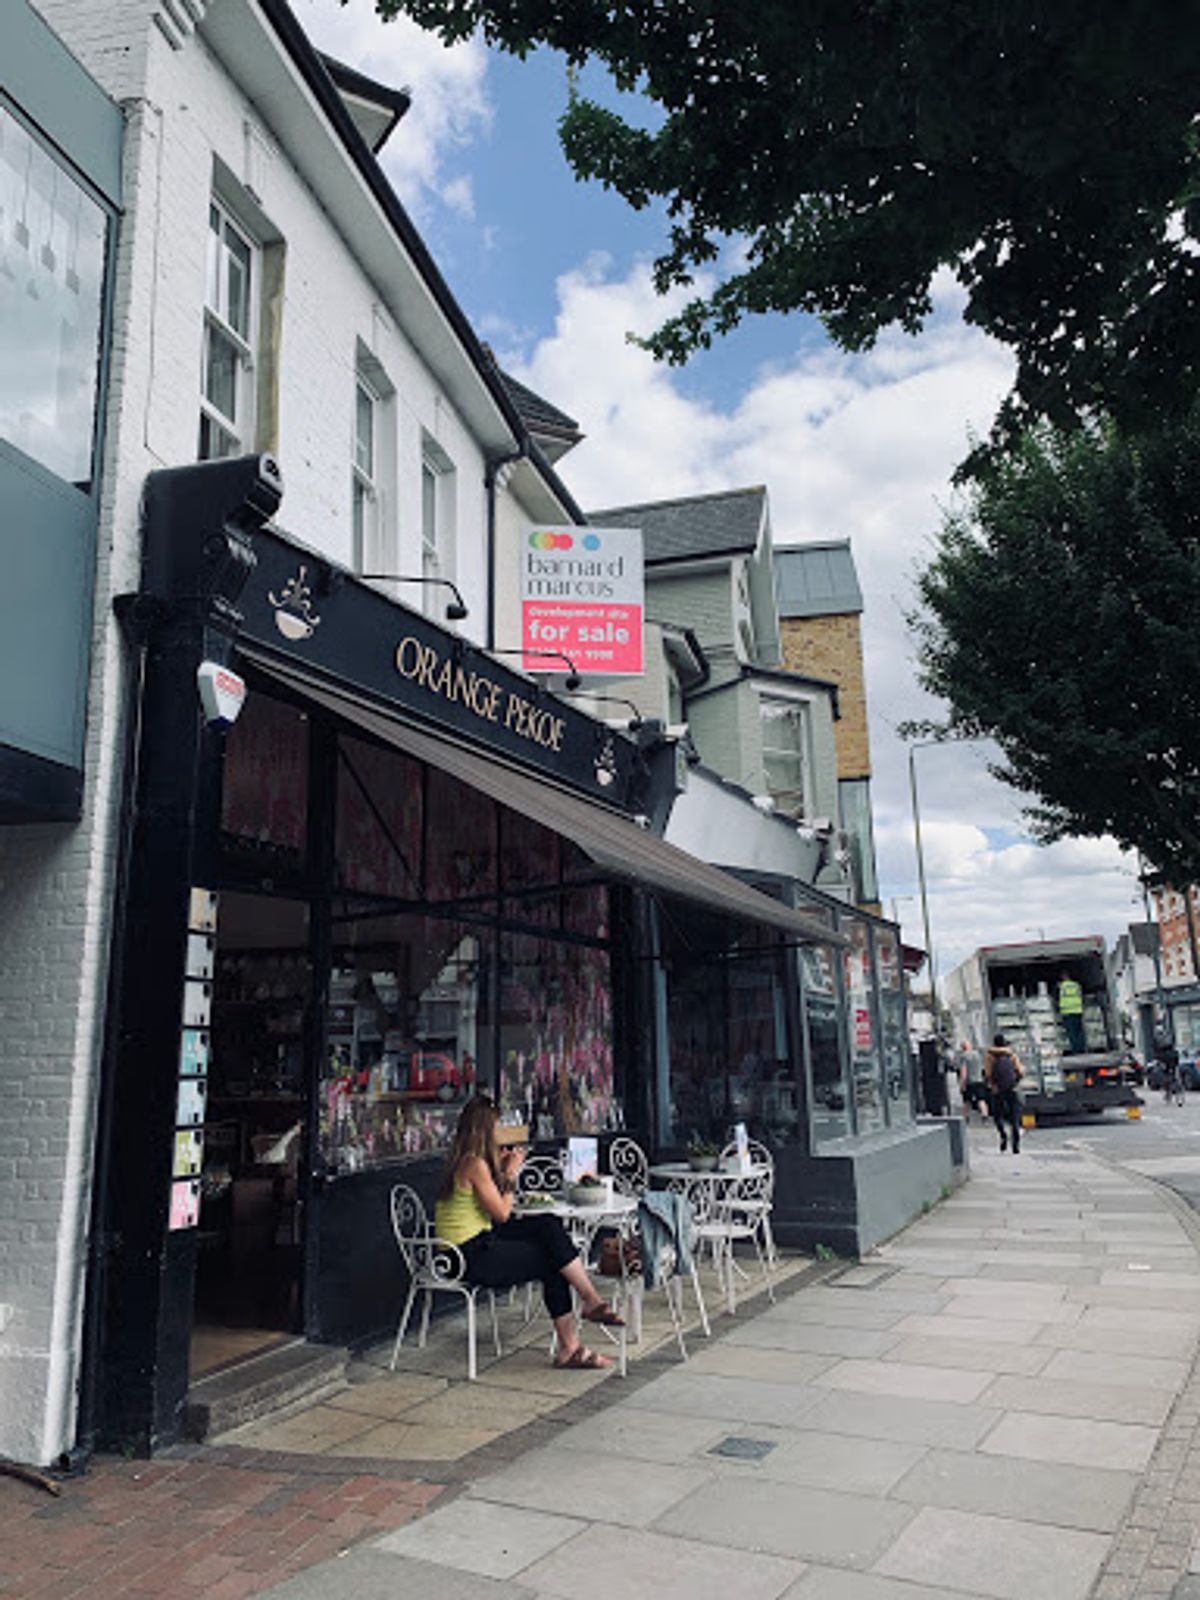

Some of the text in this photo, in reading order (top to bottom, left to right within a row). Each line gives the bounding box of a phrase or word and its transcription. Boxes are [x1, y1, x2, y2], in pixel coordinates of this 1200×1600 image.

[527, 553, 624, 577] barnard
[527, 580, 614, 597] marcus
[528, 620, 630, 644] for sale
[396, 636, 567, 752] ORANGE PEKOE
